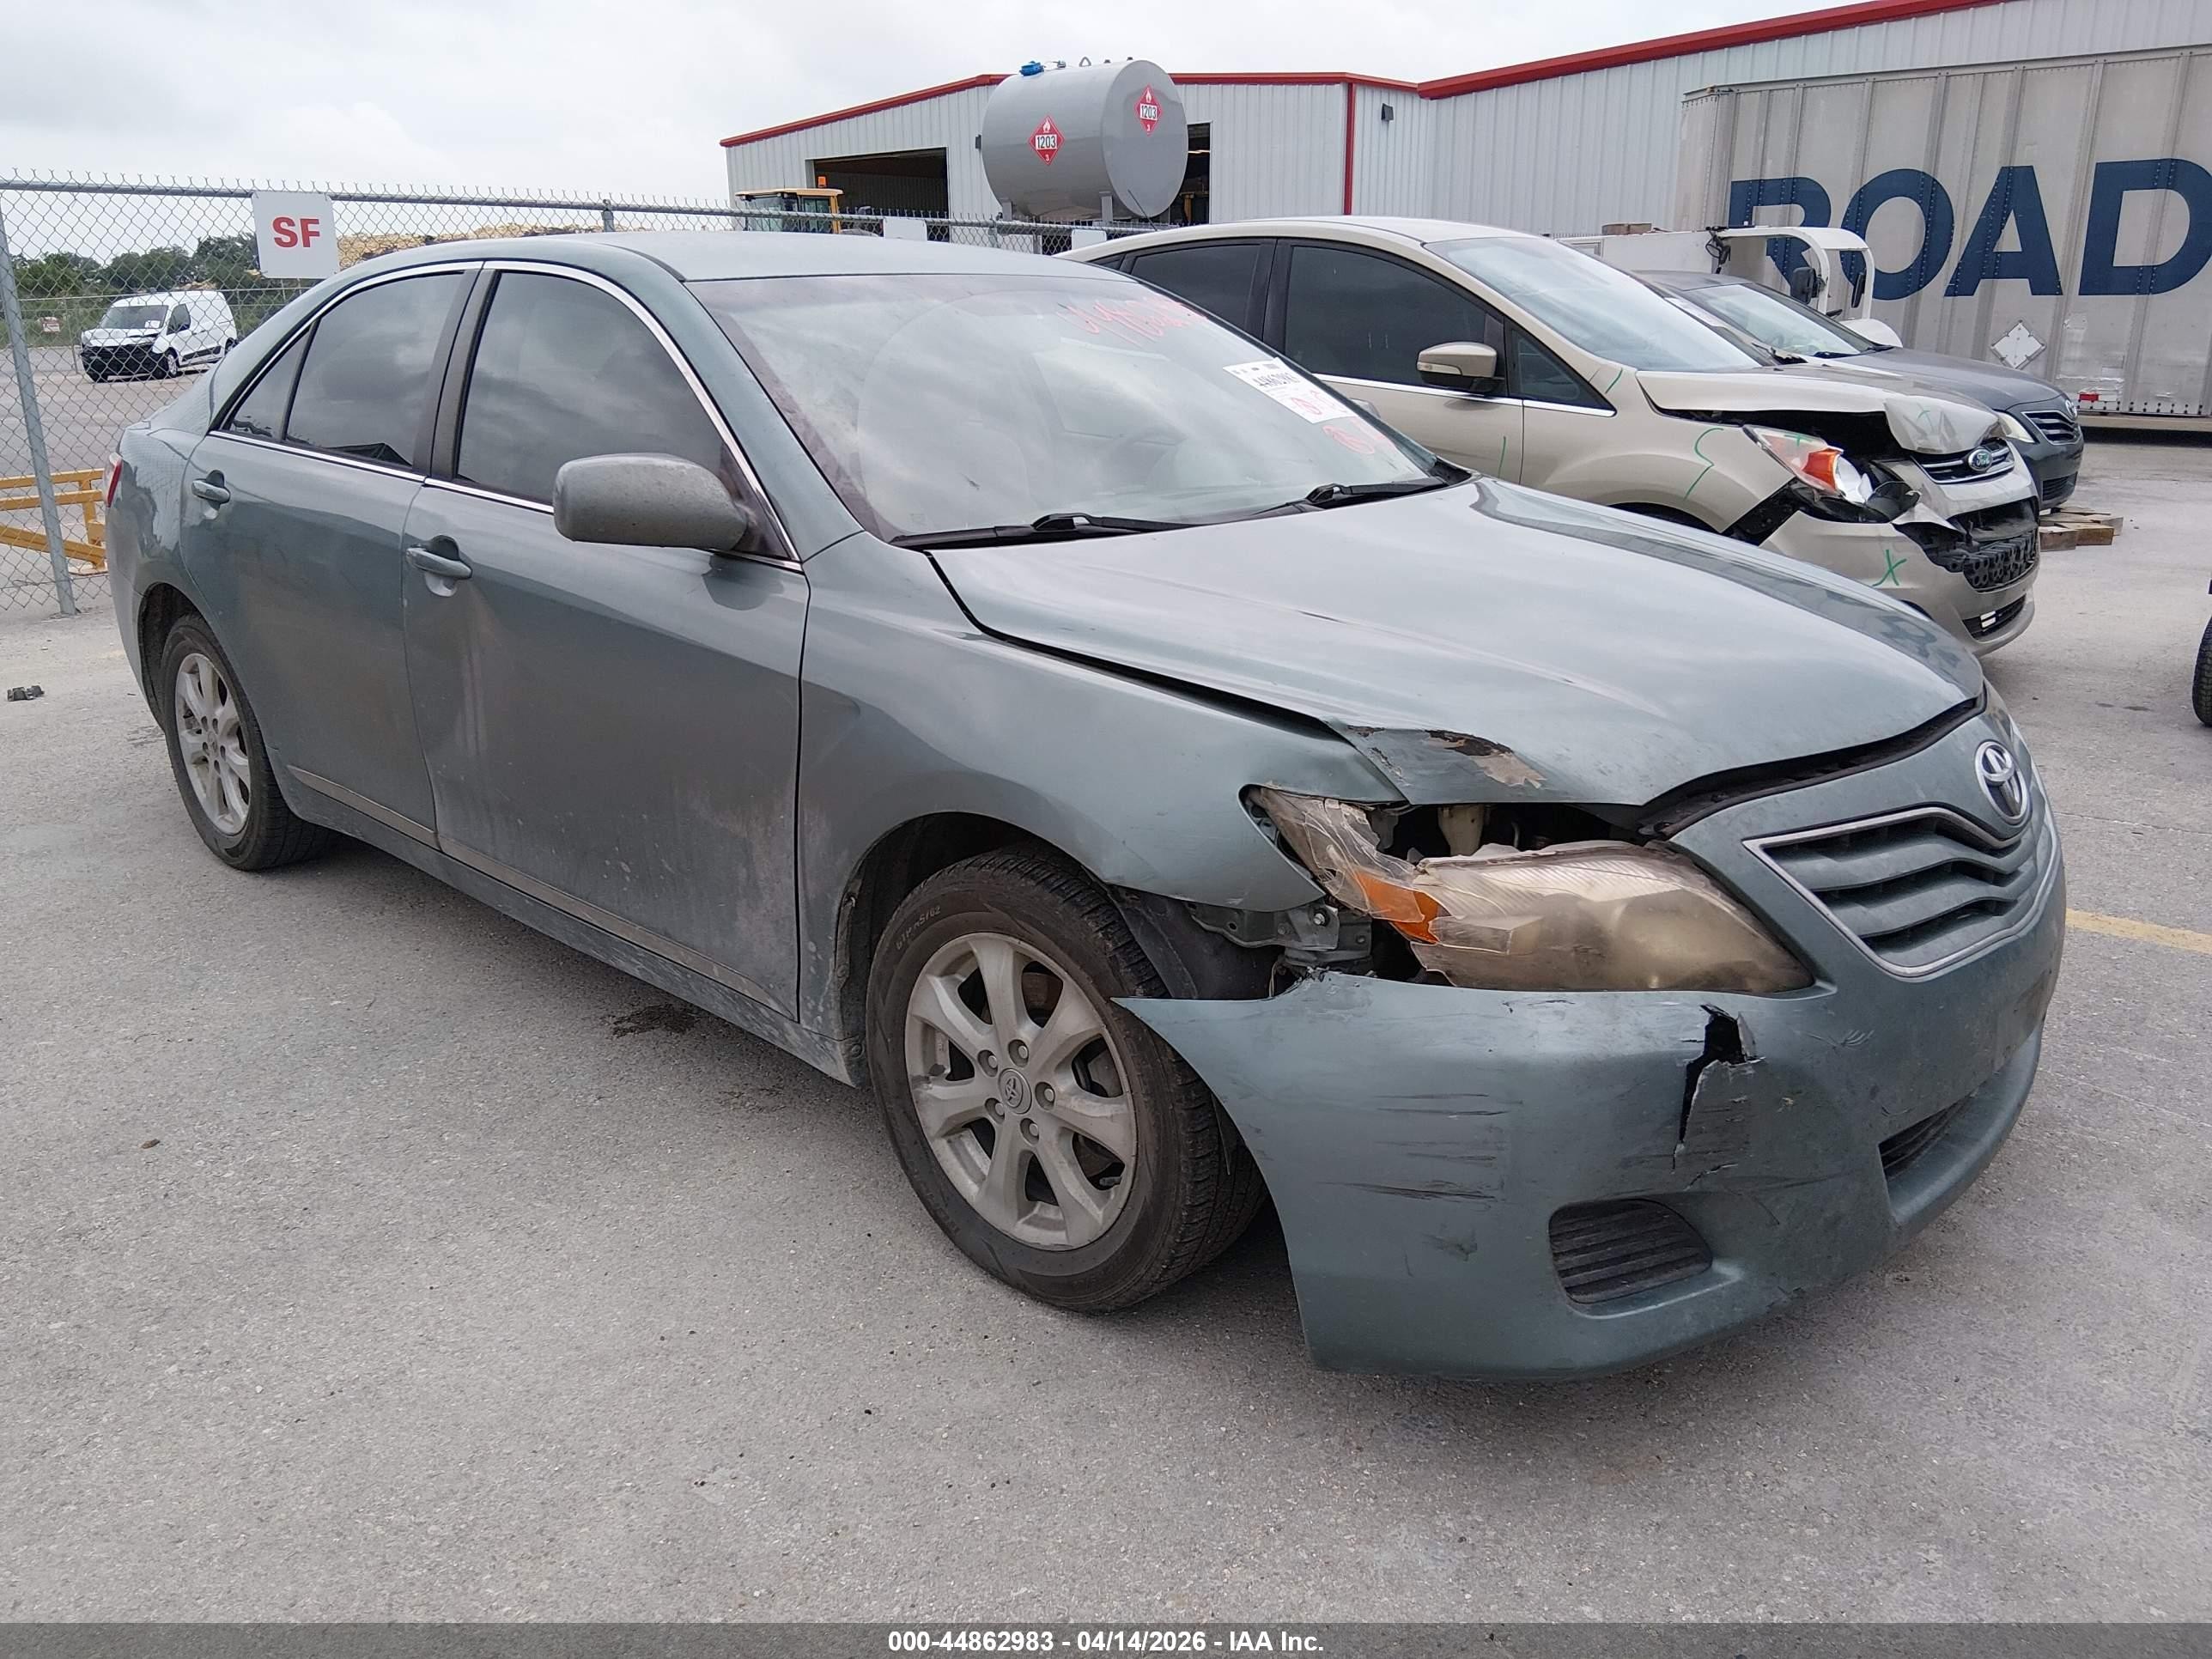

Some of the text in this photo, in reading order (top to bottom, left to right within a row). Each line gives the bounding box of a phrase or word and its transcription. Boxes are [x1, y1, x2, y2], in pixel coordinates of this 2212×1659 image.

[1141, 105, 1157, 119] 1203
[1036, 136, 1056, 149] 1203
[272, 216, 320, 248] SF
[1729, 158, 2212, 301] ROAD
